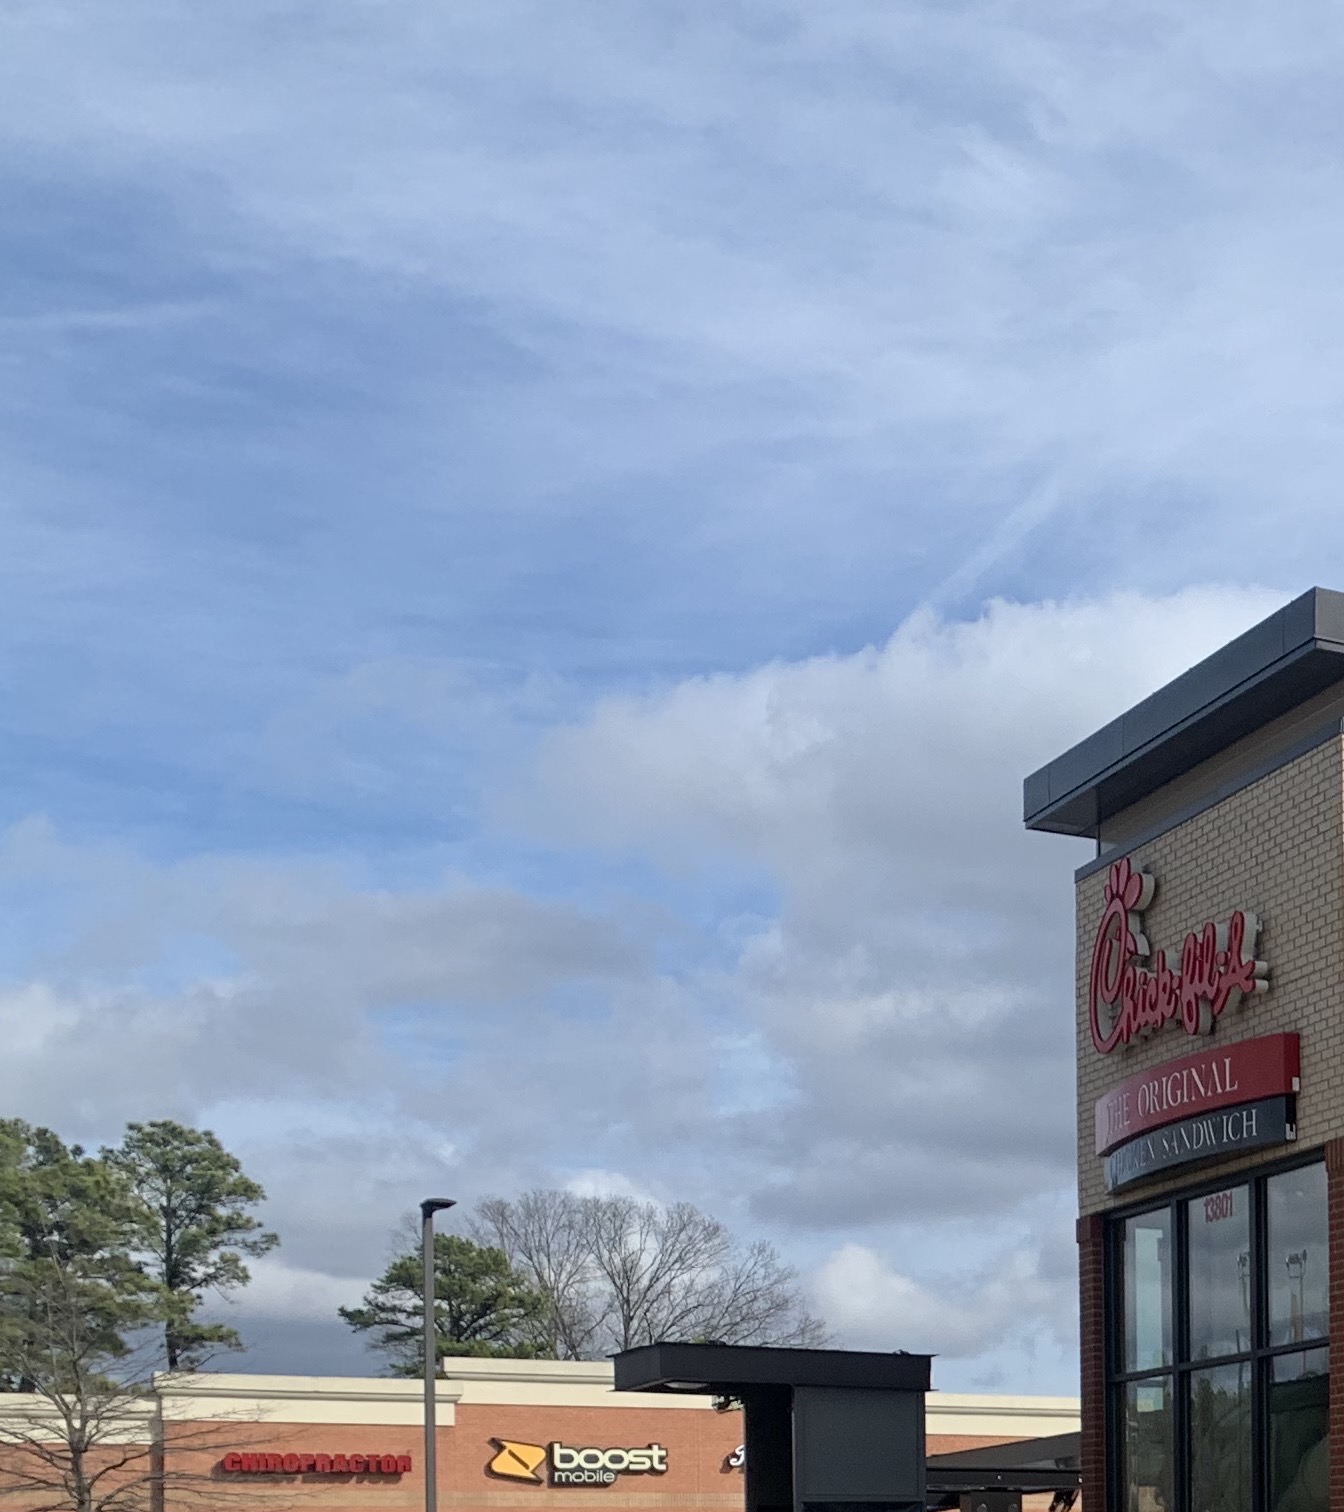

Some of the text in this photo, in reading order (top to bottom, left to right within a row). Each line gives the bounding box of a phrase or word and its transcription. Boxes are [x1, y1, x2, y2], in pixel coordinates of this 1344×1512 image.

[1107, 1057, 1238, 1134] THE ORIGINAL
[1162, 1108, 1258, 1160] SANDWICH
[223, 1452, 412, 1473] CHIROPRACTOR
[553, 1442, 667, 1471] boost
[554, 1470, 616, 1483] mobile
